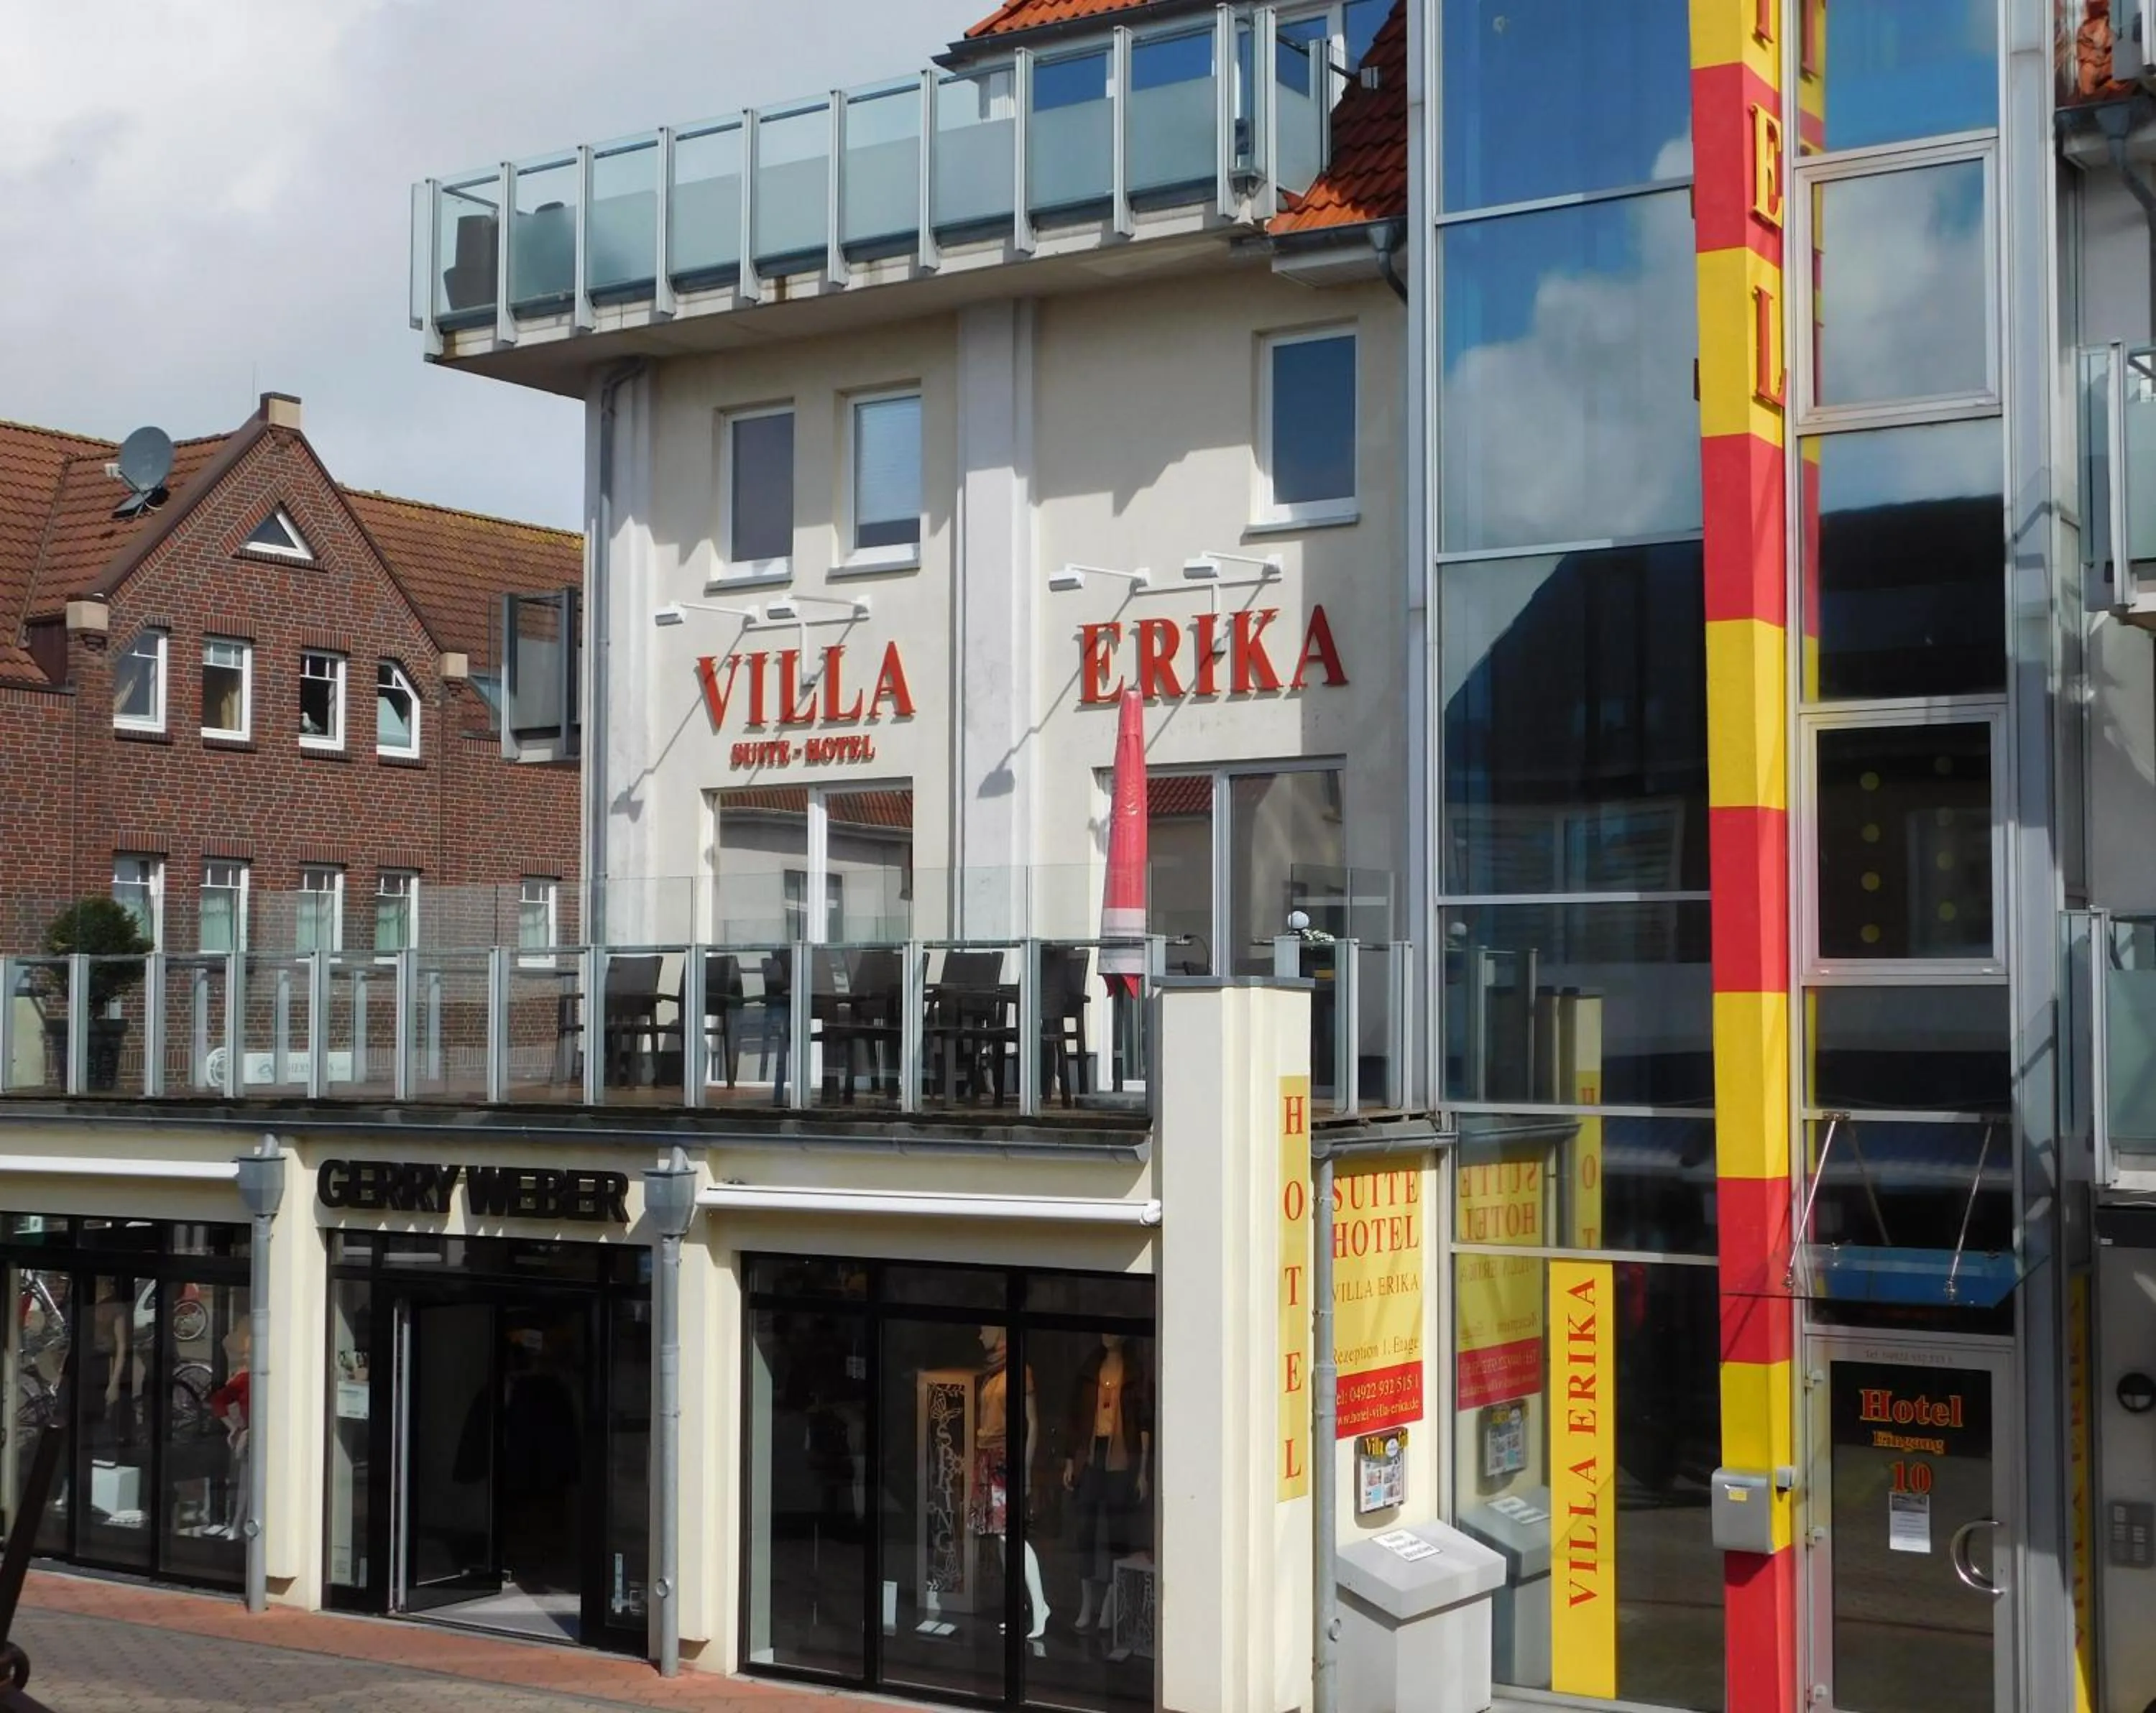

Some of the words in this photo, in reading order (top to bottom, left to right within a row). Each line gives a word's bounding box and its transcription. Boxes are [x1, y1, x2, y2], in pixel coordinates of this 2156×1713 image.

[696, 640, 916, 731] VILLA
[1080, 604, 1349, 705] ERIKA
[317, 1159, 461, 1213] GERRY
[466, 1165, 630, 1223] WEBER
[1333, 1169, 1419, 1211] SUITE
[1333, 1214, 1419, 1258] HOTEL
[1333, 1280, 1373, 1303] VILLA
[1378, 1273, 1419, 1296] ERIKA
[1567, 1278, 1597, 1436] ERIKA
[1859, 1389, 1963, 1428] Hotel
[1890, 1460, 1932, 1494] 10
[1567, 1456, 1598, 1607] VILLA
